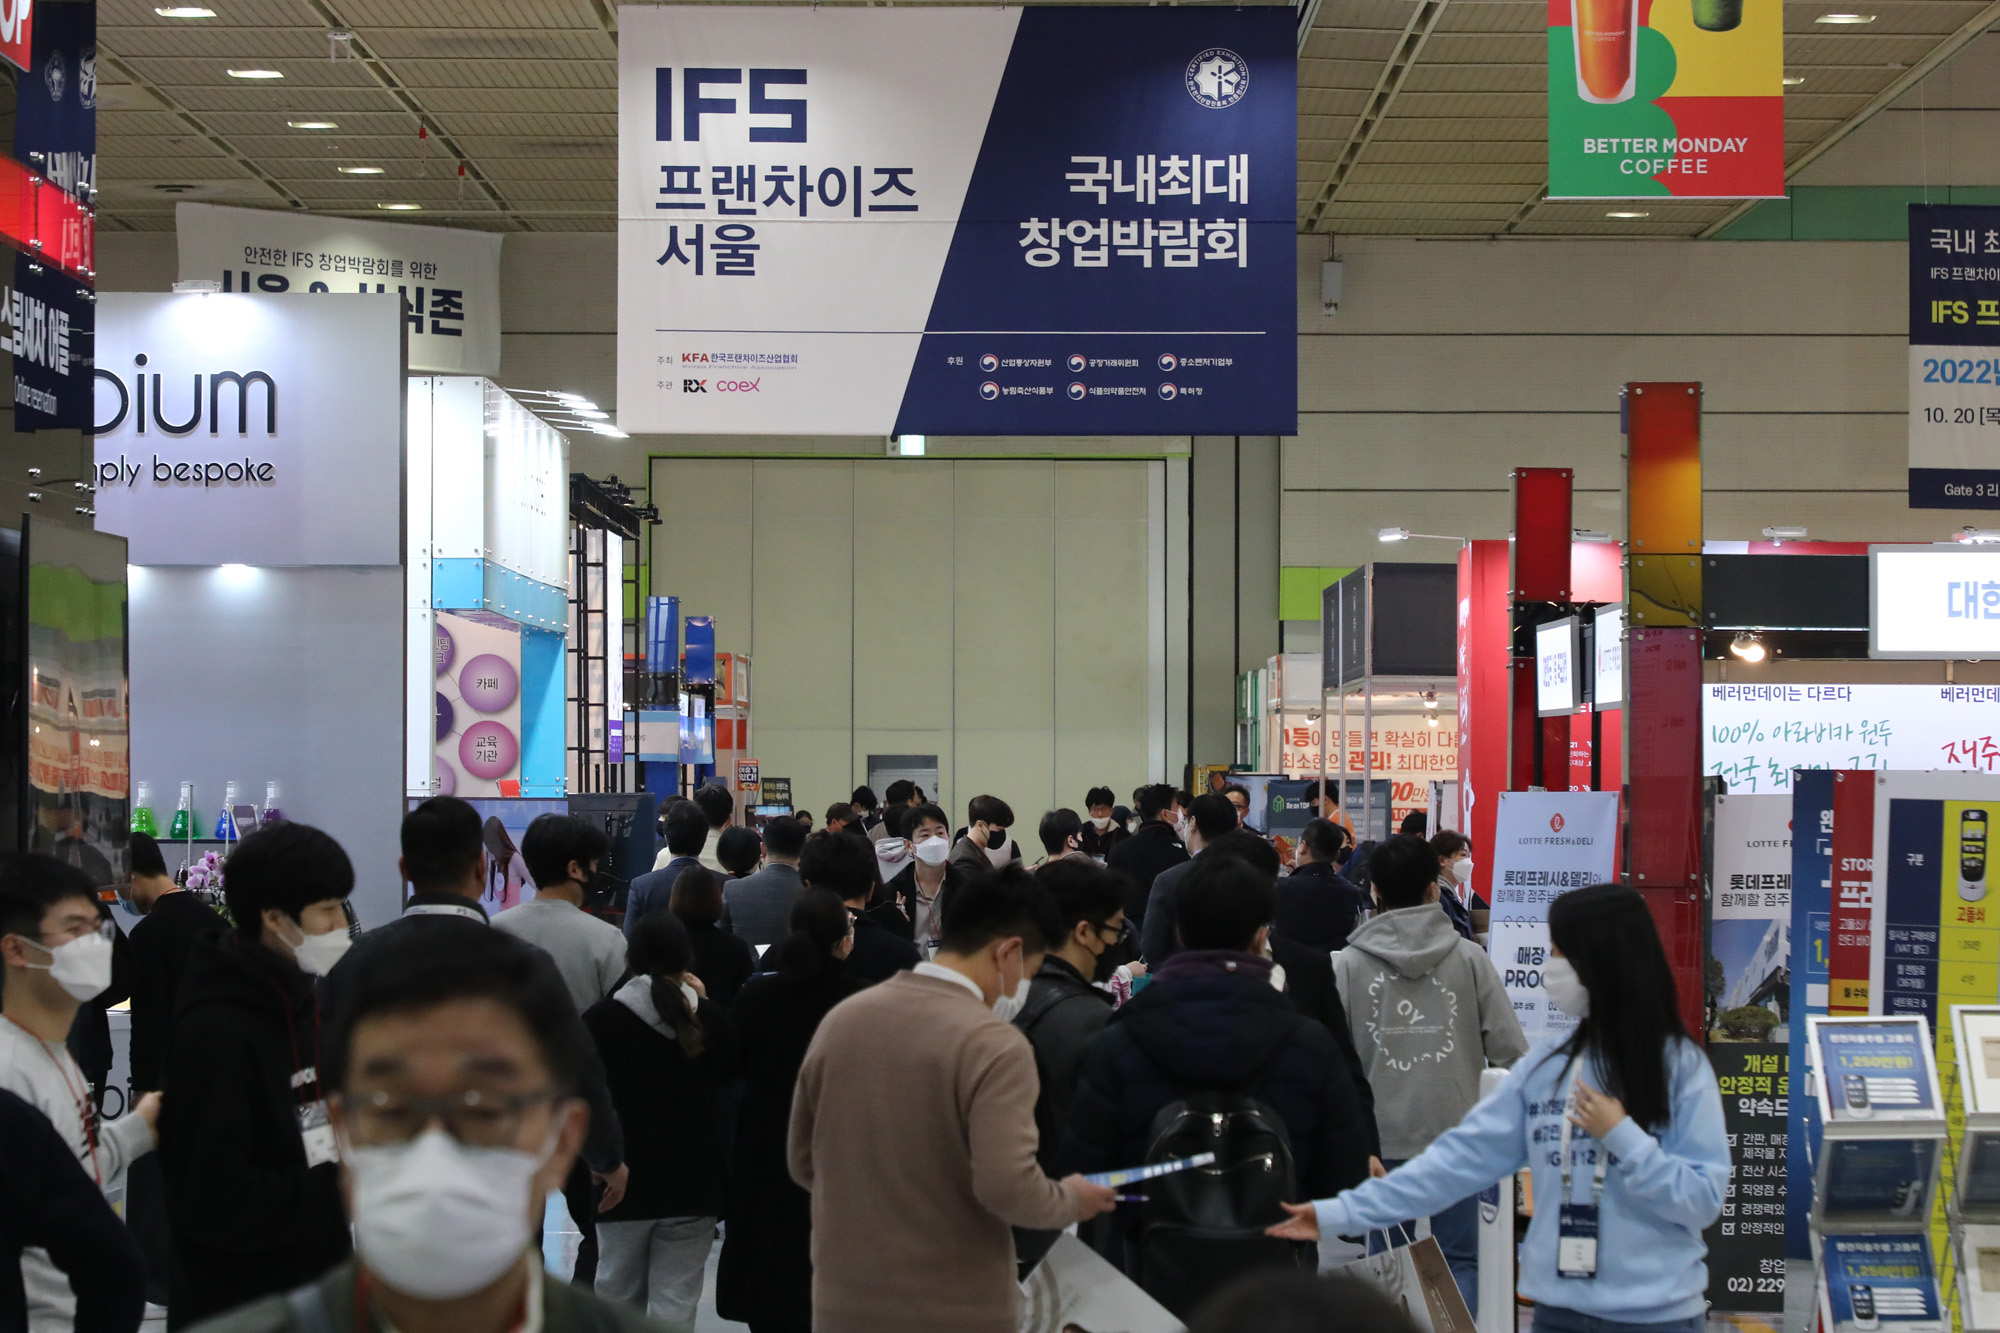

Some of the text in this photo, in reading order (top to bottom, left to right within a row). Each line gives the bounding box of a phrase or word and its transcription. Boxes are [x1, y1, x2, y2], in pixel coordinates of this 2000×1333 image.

[656, 67, 807, 143] IFS
[1583, 137, 1748, 153] BETTER MONDAY
[1620, 159, 1708, 174] COFFEE
[1065, 154, 1248, 204] 국내최대
[656, 164, 919, 217] 프랜차이즈
[1018, 218, 1247, 268] 창업박람회
[1930, 229, 1975, 254] 국내
[656, 224, 760, 276] 서울
[244, 246, 437, 281] 안전한 IFS 창업박람회를 위한
[1931, 267, 1949, 279] IFS
[1932, 301, 1968, 324] IFS
[657, 353, 798, 366] 주최 KFA 한국프랜차이즈산업협회
[947, 356, 964, 366] 후원
[1089, 358, 1139, 368] 공정거래위원회
[1180, 357, 1233, 367] 중소벤처기업부
[657, 377, 761, 393] 주관 RX coex
[1002, 386, 1203, 396] 농림축산식품부 식품의약품안전처 특허청
[1924, 407, 1949, 424] 10.
[1954, 407, 1974, 424] 20
[94, 455, 274, 487] ply bespoke
[1944, 484, 1972, 496] Gate
[1976, 484, 1983, 496] 3
[476, 678, 498, 690] 카페
[1712, 686, 1852, 701] 베러먼데이는 다르다
[1384, 731, 1431, 748] 확실히
[1712, 719, 1893, 747] 100% 아라비카 원두
[475, 736, 498, 748] 교육
[475, 751, 498, 763] 기관
[1747, 840, 1779, 848] LOTTE
[1906, 853, 1924, 866] 구분
[1730, 874, 1791, 890] 롯데프레
[1497, 889, 1525, 903] 함께할
[1721, 893, 1790, 907] 함께할 점주
[1517, 947, 1545, 966] 매장
[1744, 1054, 1778, 1073] 개설
[1719, 1076, 1771, 1095] 안정적
[1743, 1133, 1767, 1146] 간판,
[1742, 1147, 1775, 1159] 제작물
[1742, 1165, 1764, 1177] 전산
[1742, 1184, 1774, 1196] 직영점
[1741, 1222, 1785, 1235] 안정적인
[1727, 1277, 1753, 1293] 02)
